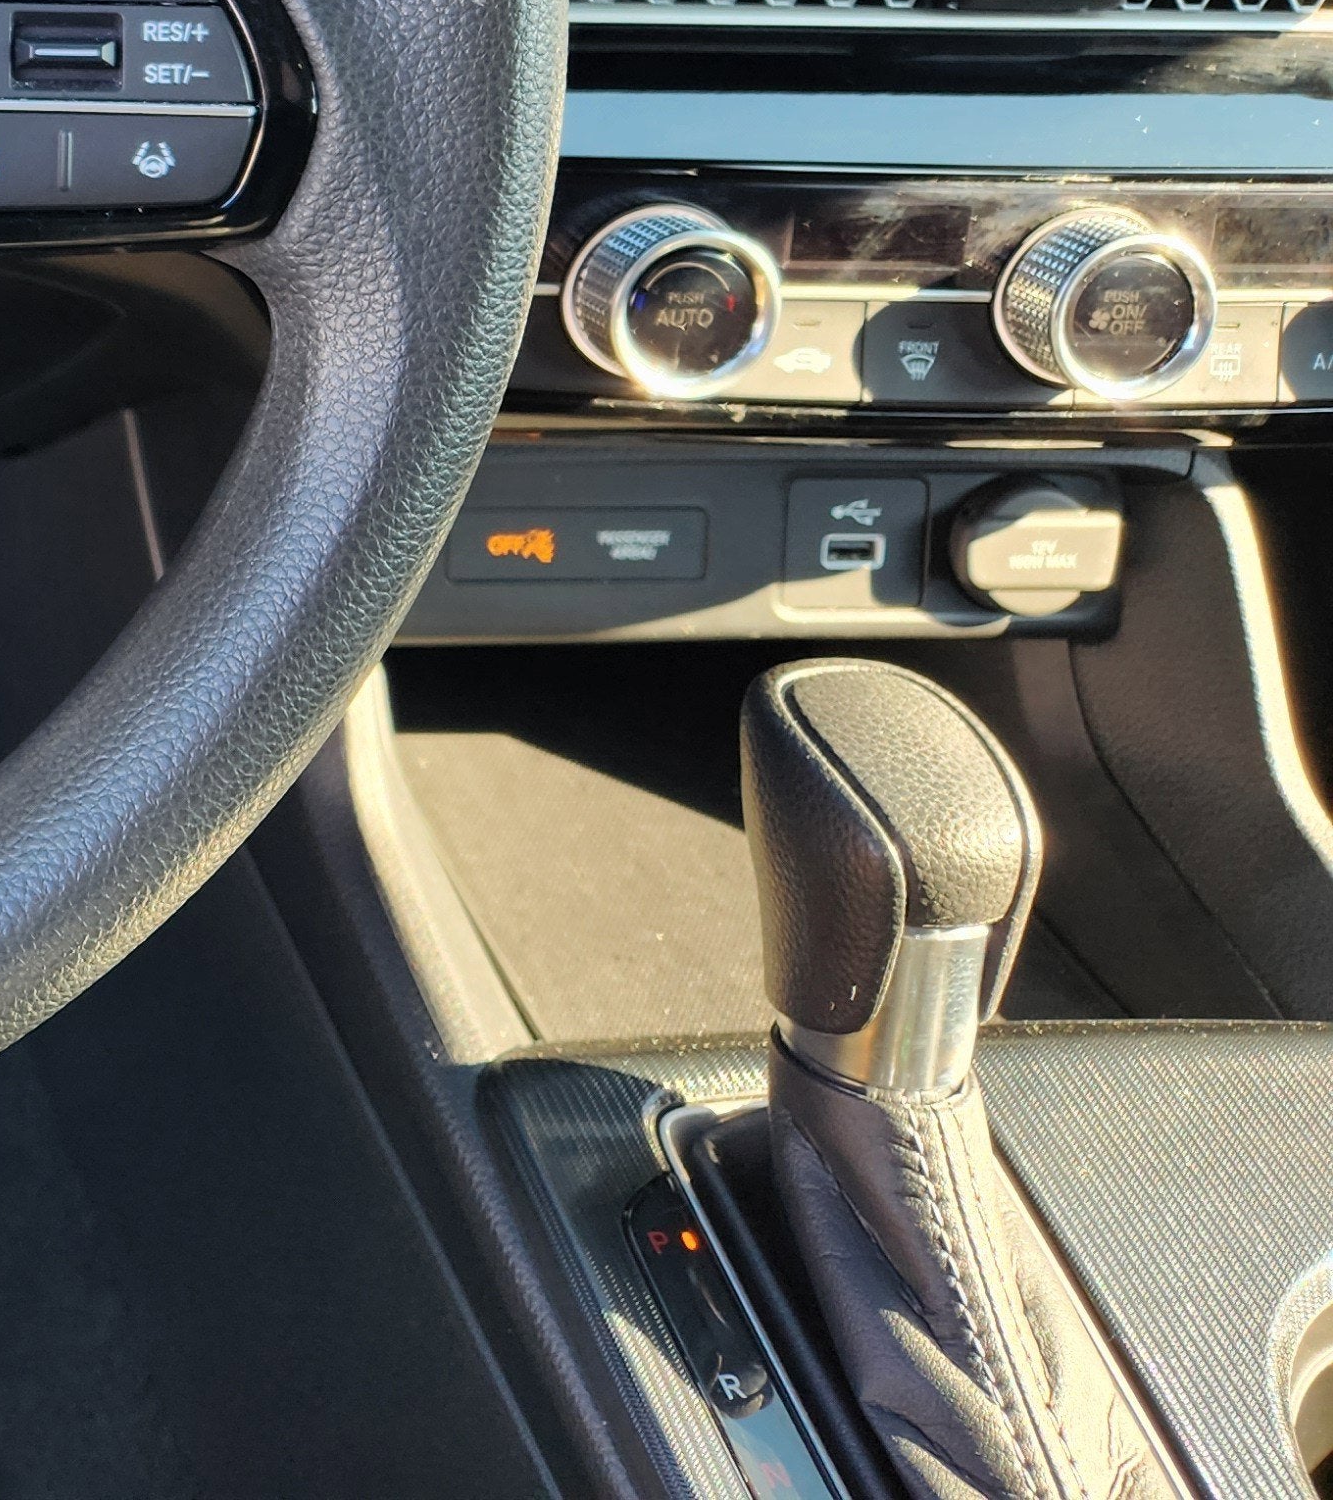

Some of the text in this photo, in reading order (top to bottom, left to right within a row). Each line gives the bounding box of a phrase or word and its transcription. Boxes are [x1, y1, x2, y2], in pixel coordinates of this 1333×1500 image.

[142, 21, 210, 44] RES/+
[667, 290, 705, 304] PUSH
[1103, 289, 1141, 304] PUSH
[654, 307, 714, 329] AUTO
[1109, 320, 1146, 336] OFF
[898, 340, 940, 354] FRONT
[1209, 342, 1243, 356] REAR
[646, 1231, 669, 1254] P
[717, 1372, 748, 1401] R
[761, 1463, 793, 1489] N
